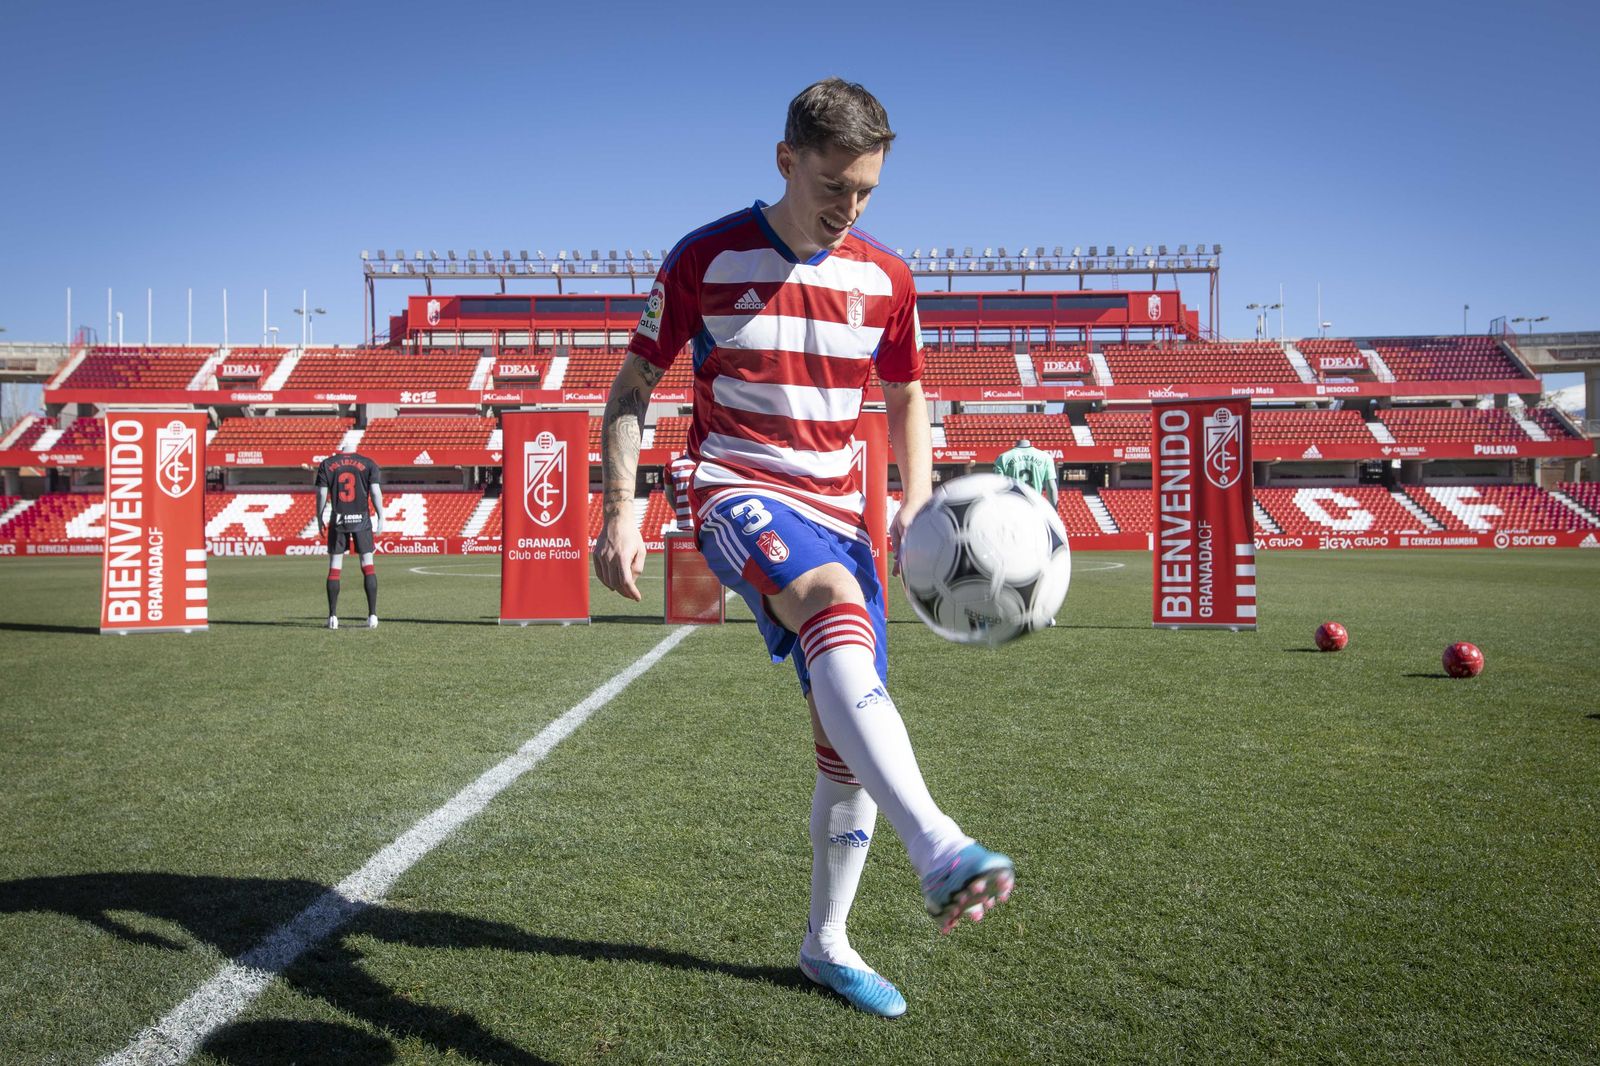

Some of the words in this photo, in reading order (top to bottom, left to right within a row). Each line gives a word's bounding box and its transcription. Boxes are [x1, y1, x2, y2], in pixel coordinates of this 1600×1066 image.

[734, 302, 766, 310] adidas
[1043, 361, 1082, 371] IDEAL
[1319, 357, 1363, 368] IDEAL
[222, 364, 263, 375] IDEAL
[499, 364, 539, 375] IDEAL
[990, 390, 1022, 398] CaixaBank
[1231, 386, 1255, 396] Jurado
[1256, 386, 1274, 395] Mata
[1474, 445, 1518, 455] PULEVA
[338, 472, 356, 503] 3
[730, 498, 773, 536] 3
[1160, 409, 1192, 618] BIENVENIDO
[107, 420, 143, 623] BIENVENIDO
[518, 538, 572, 548] GRANADA
[1269, 537, 1303, 547] GRUPO
[1354, 536, 1389, 546] GRUPO
[1411, 536, 1442, 546] CERVEZAS
[1443, 536, 1478, 546] ALHAMBRA
[1512, 535, 1557, 546] sorare
[384, 541, 440, 554] CaixaBank
[508, 549, 532, 560] Club
[534, 549, 547, 560] de
[549, 549, 580, 560] Fútbol
